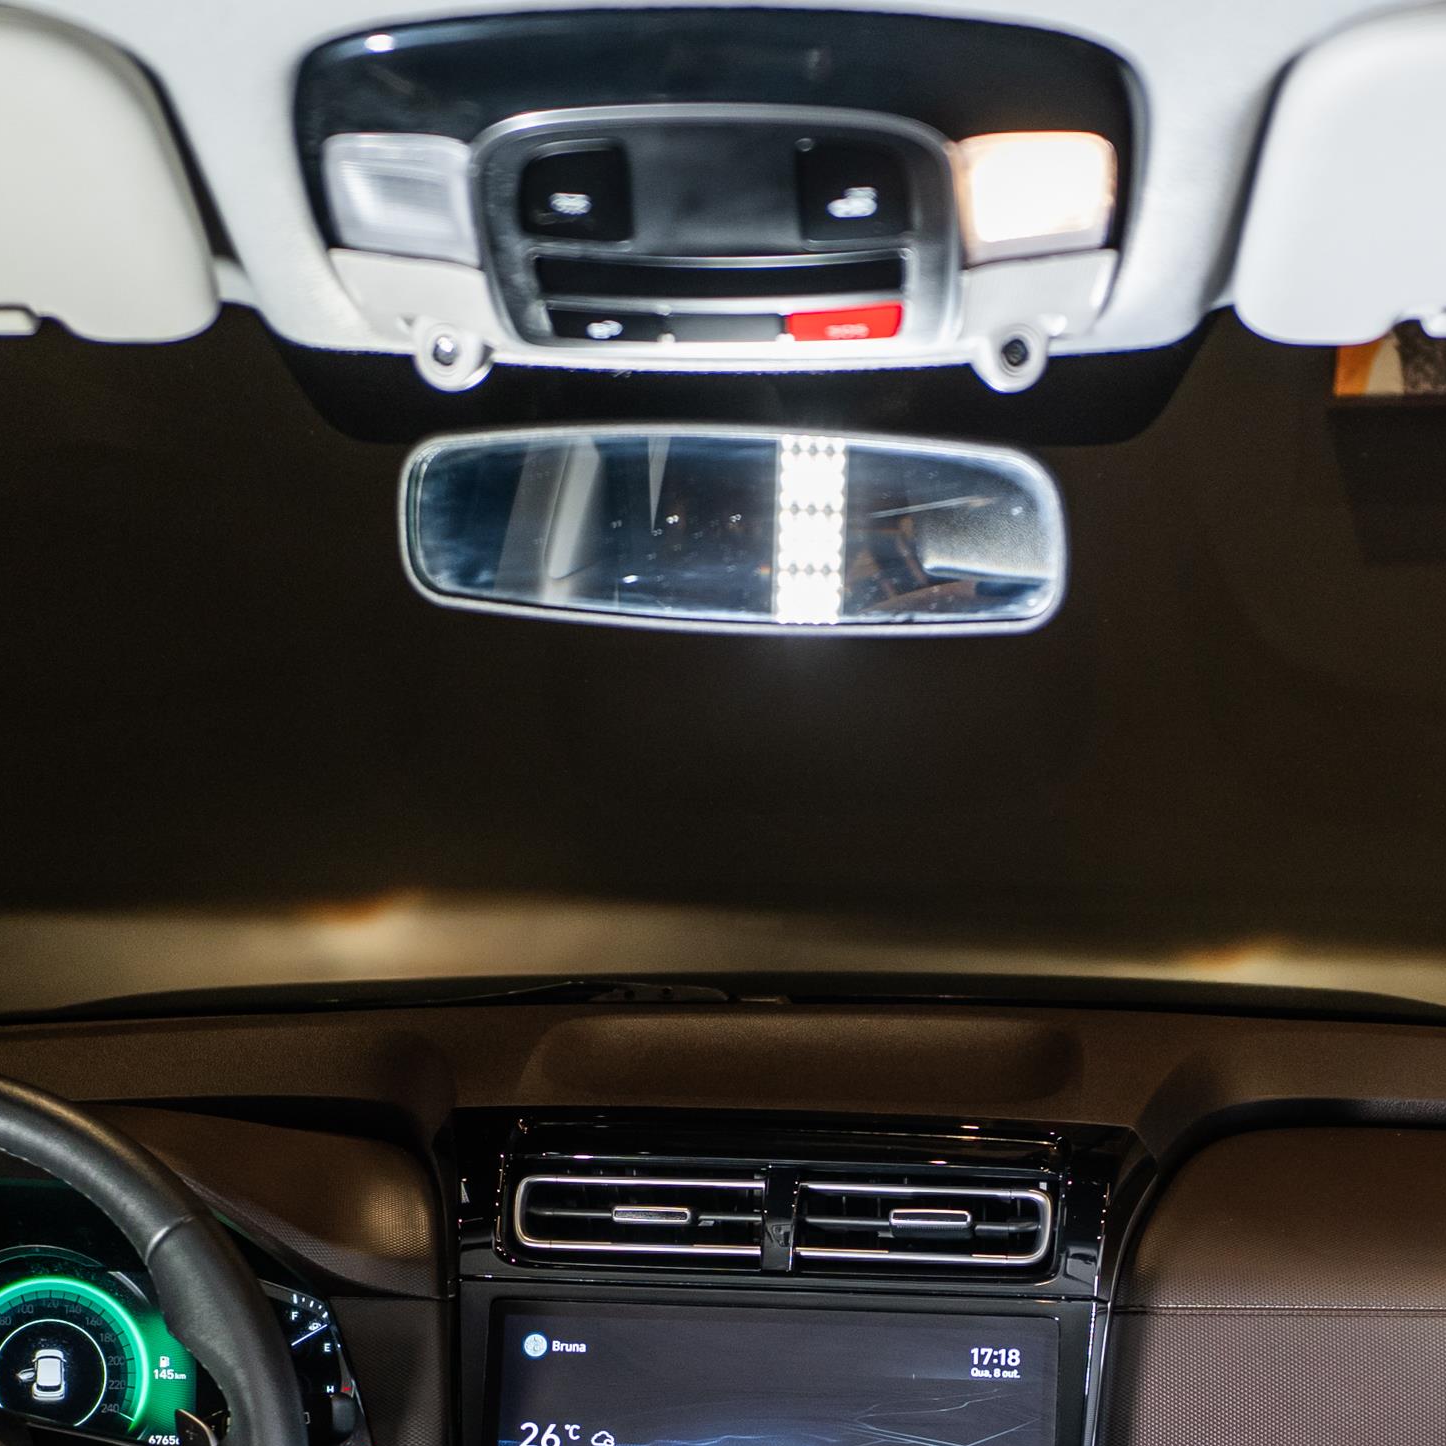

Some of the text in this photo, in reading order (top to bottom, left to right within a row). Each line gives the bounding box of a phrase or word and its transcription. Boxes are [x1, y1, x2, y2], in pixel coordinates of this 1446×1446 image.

[291, 1311, 299, 1321] F
[324, 1343, 331, 1352] E
[552, 1340, 586, 1352] Bruna
[108, 1356, 125, 1366] 200
[970, 1347, 1020, 1366] 17:18
[970, 1367, 1021, 1378] Qua, 8 out.
[109, 1380, 126, 1390] 220
[101, 1403, 119, 1413] 240
